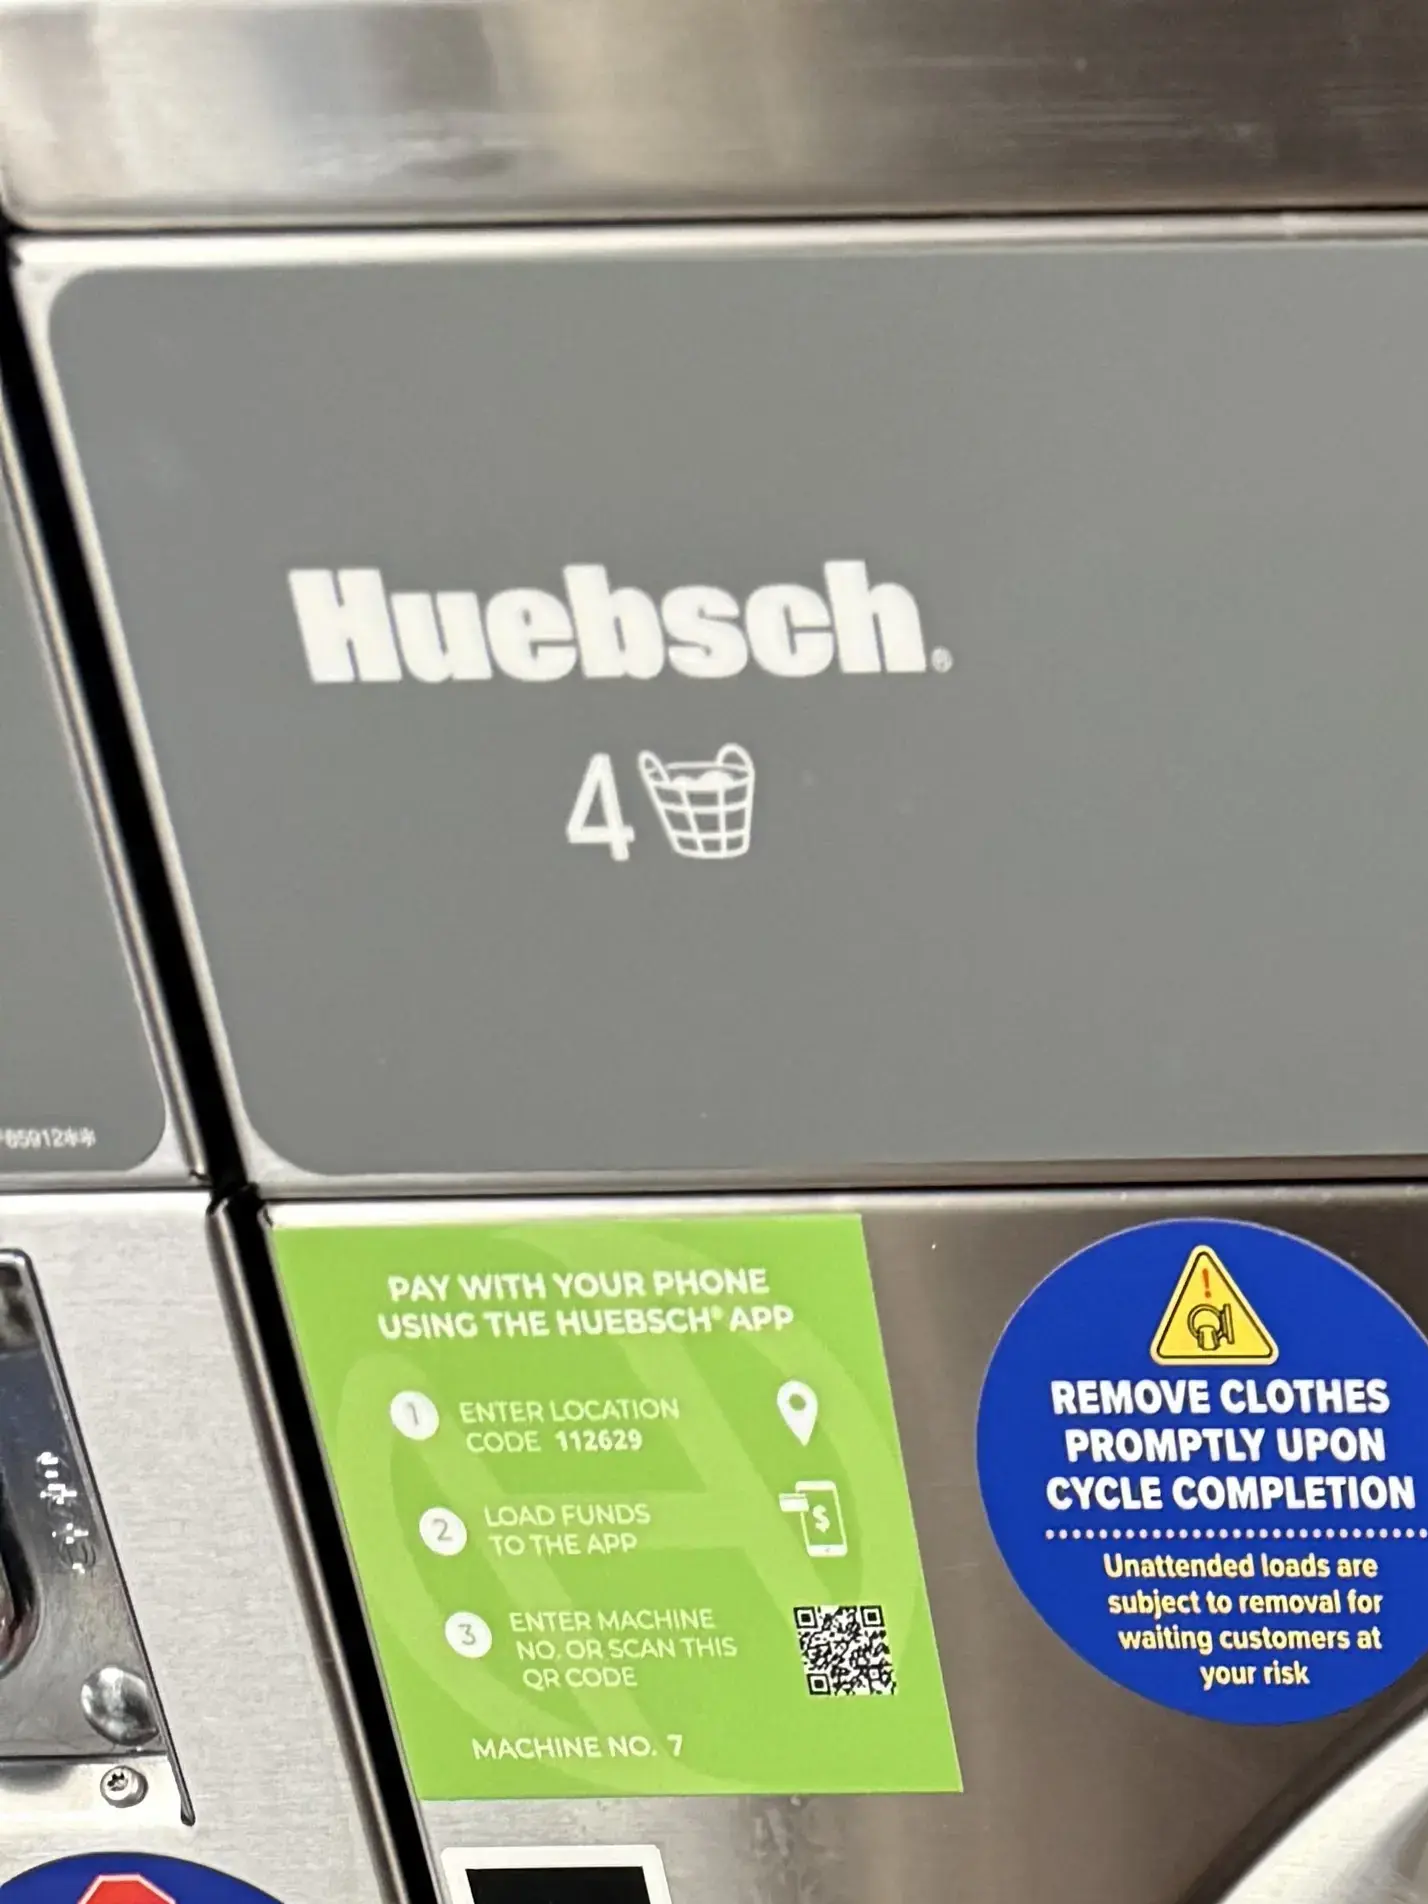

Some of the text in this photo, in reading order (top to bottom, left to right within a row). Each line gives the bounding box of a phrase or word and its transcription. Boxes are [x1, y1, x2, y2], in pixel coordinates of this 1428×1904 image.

[566, 753, 635, 861] 4
[388, 1269, 769, 1301] PAY WITH YOUR PHONE
[378, 1312, 478, 1340] USING
[483, 1310, 549, 1337] THE
[730, 1305, 793, 1331] APP
[460, 1397, 680, 1423] ENTER LOCATION
[1051, 1379, 1390, 1414] REMOVE CLOTHES
[466, 1429, 642, 1453] CODE 112629
[1065, 1428, 1385, 1462] PROMPTLY UPON
[1047, 1476, 1415, 1510] CYCLE COMPLETION
[484, 1503, 651, 1527] LOAD FUNDS
[489, 1533, 637, 1556] TO THE APP
[1104, 1553, 1378, 1578] Unattended loads are
[1108, 1589, 1383, 1619] subject to removal for
[510, 1608, 715, 1632] ENTER MACHINE
[516, 1637, 737, 1660] NO. OR SCAN THIS
[1118, 1624, 1382, 1655] waiting customers at
[523, 1667, 637, 1691] QR CODE
[1200, 1660, 1310, 1690] your risk
[472, 1734, 682, 1759] MACHINE NO. 7
